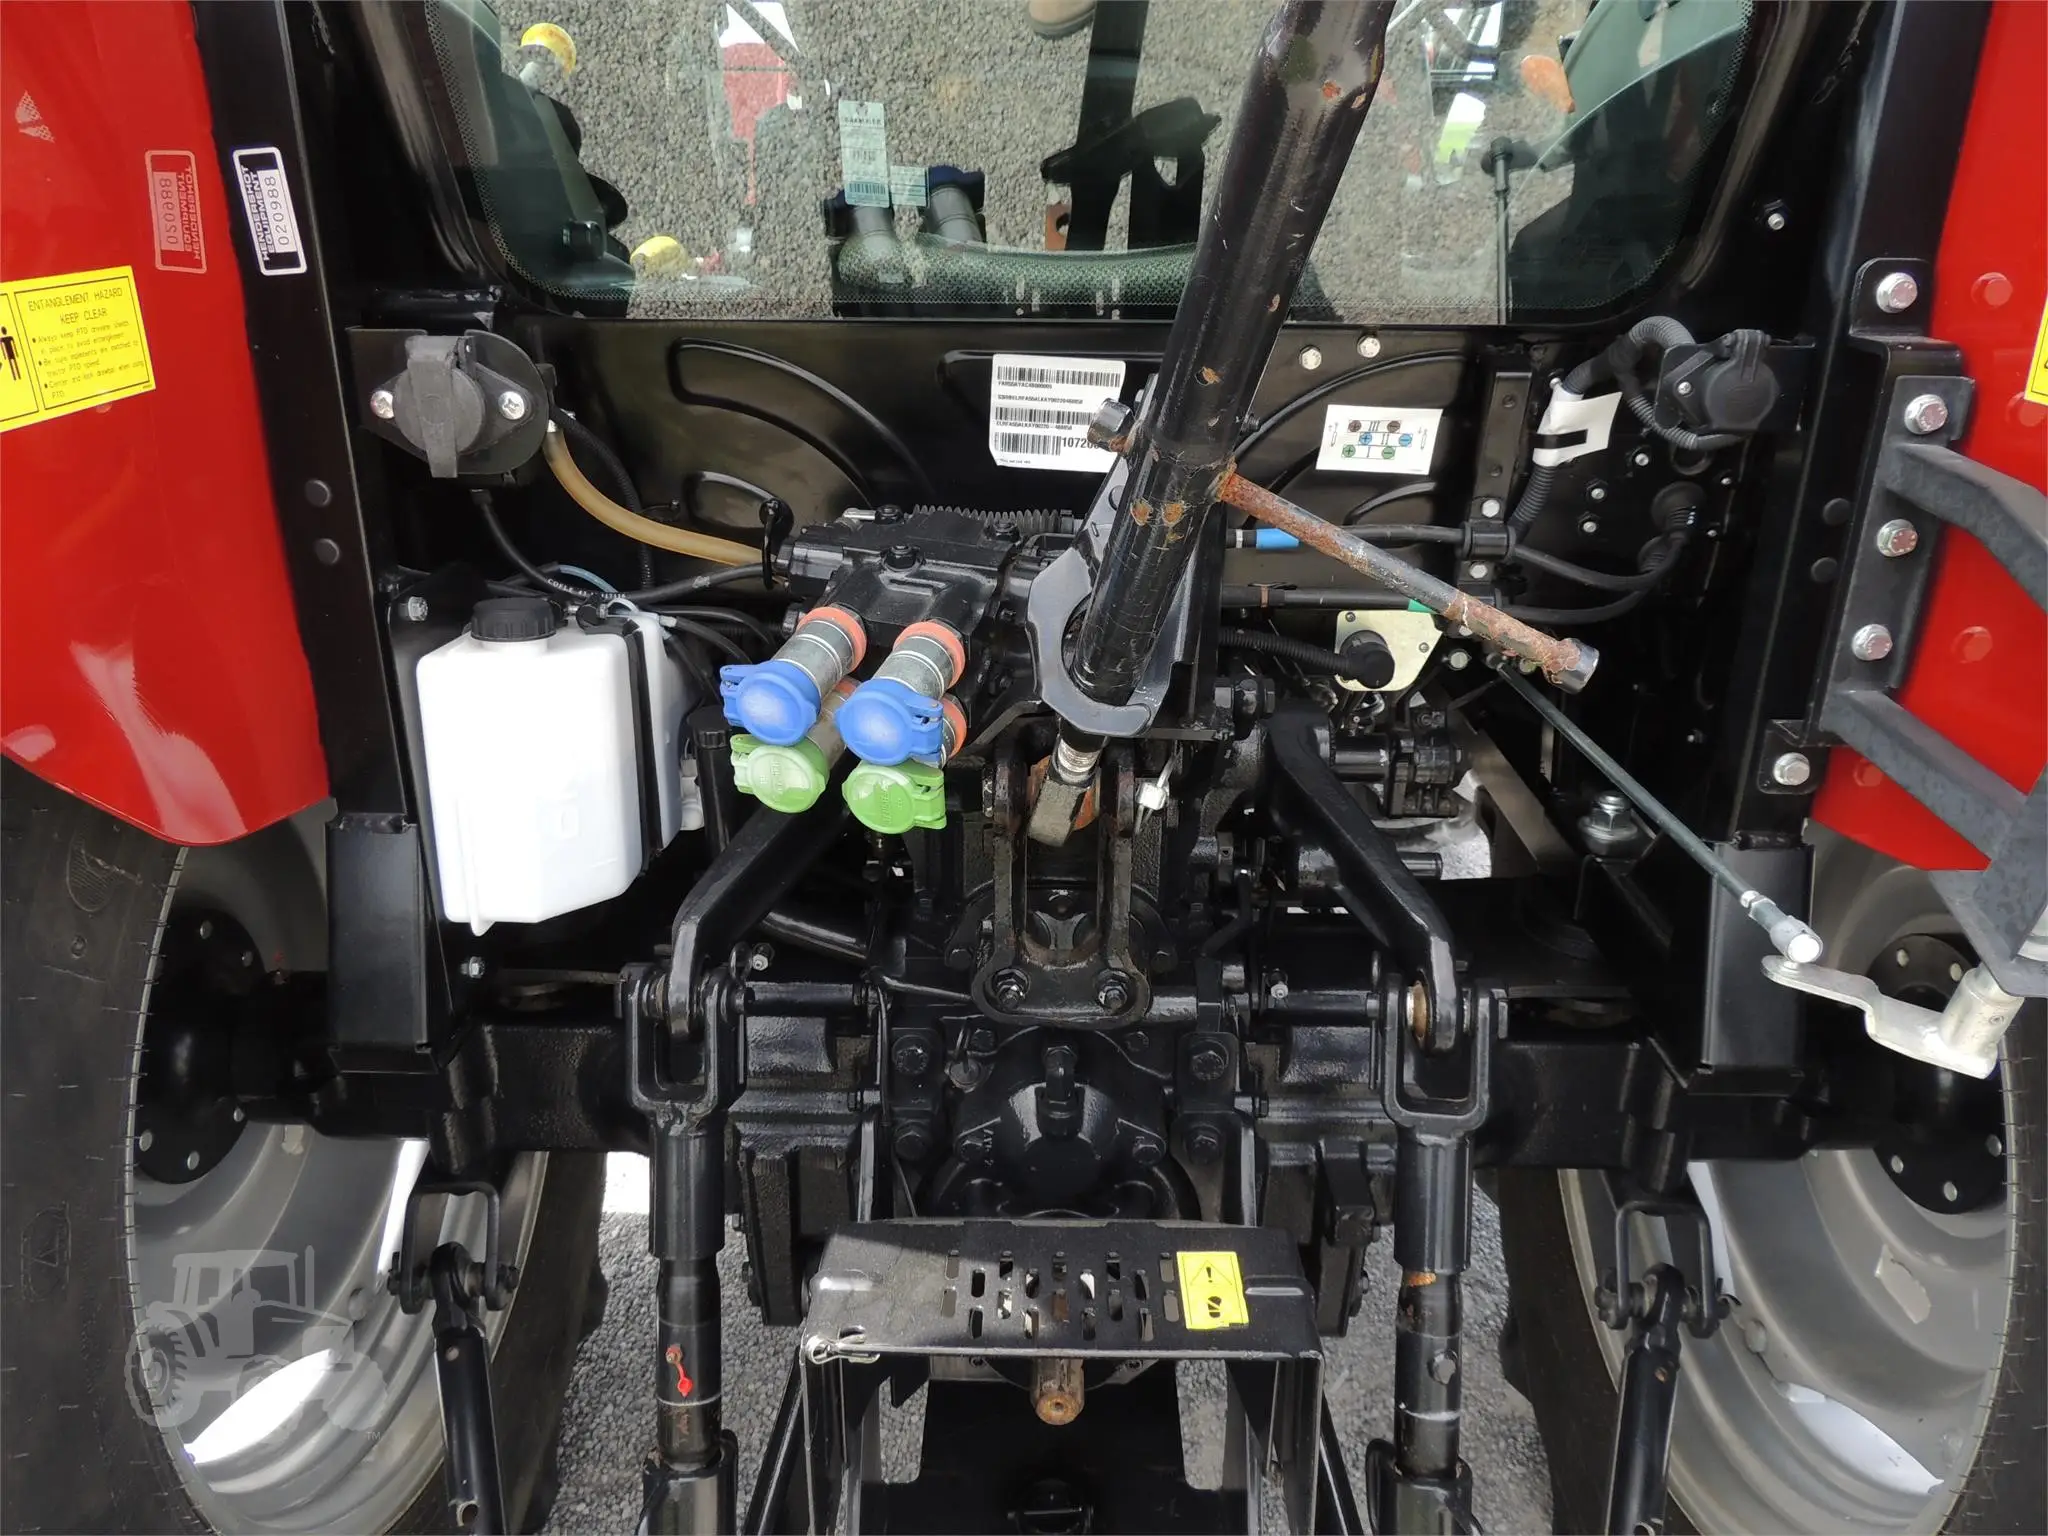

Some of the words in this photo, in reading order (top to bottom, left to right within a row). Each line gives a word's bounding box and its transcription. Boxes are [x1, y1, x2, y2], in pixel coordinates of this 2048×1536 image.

[240, 165, 270, 261] HENDERSHOT
[250, 171, 275, 254] EQUIPMENT
[264, 176, 290, 246] 020988
[28, 292, 90, 312] ENTANGLEMENT
[94, 287, 123, 301] HAZARD
[60, 312, 80, 325] KEEP
[84, 308, 108, 321] CLEAR
